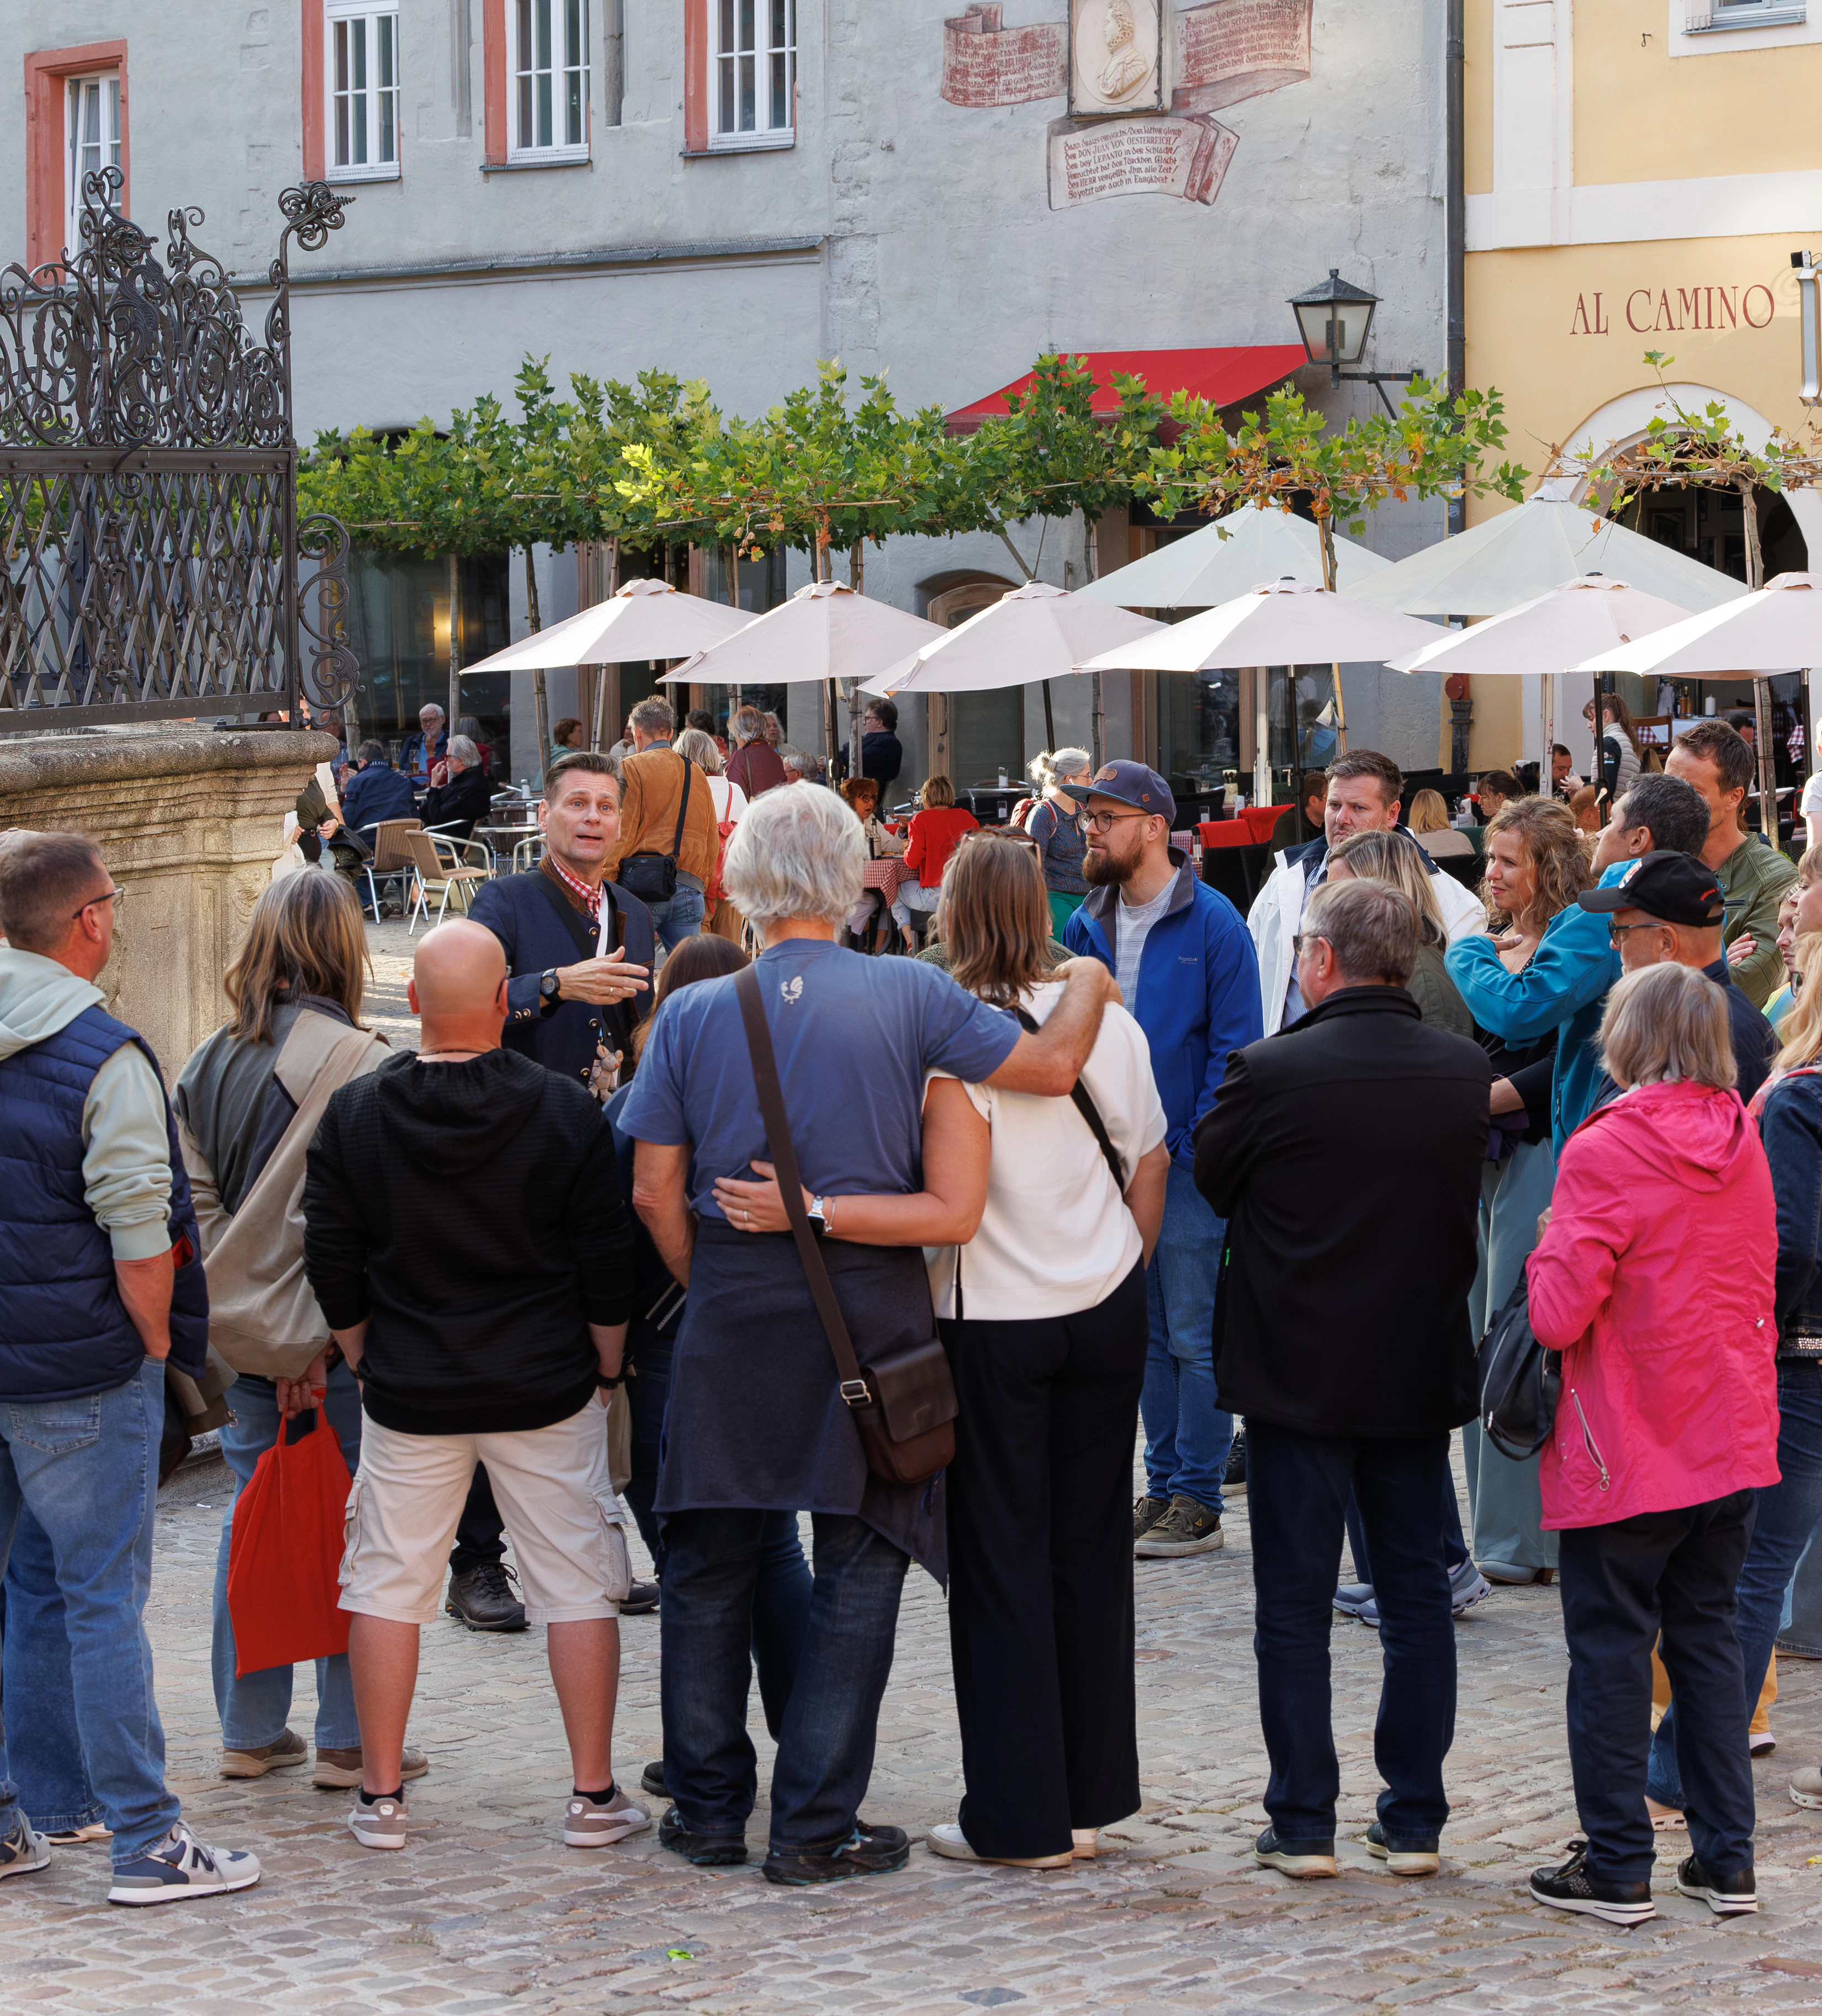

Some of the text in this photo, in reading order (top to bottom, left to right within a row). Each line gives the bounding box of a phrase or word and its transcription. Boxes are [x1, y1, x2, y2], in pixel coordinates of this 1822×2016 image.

[1163, 126, 1182, 137] gleich
[1078, 148, 1092, 158] DON
[1093, 142, 1110, 155] JUAN
[1111, 139, 1124, 150] VON
[1079, 159, 1092, 168] bey
[1093, 150, 1122, 165] LEPANTO
[1132, 146, 1143, 155] der
[1100, 163, 1110, 173] hat
[1111, 160, 1123, 168] der
[1154, 155, 1177, 165] Macht
[1079, 176, 1097, 188] HERR
[1145, 165, 1157, 173] alle
[1095, 184, 1106, 193] wie
[1108, 178, 1124, 190] auch
[1570, 284, 1776, 336] AL CAMINO
